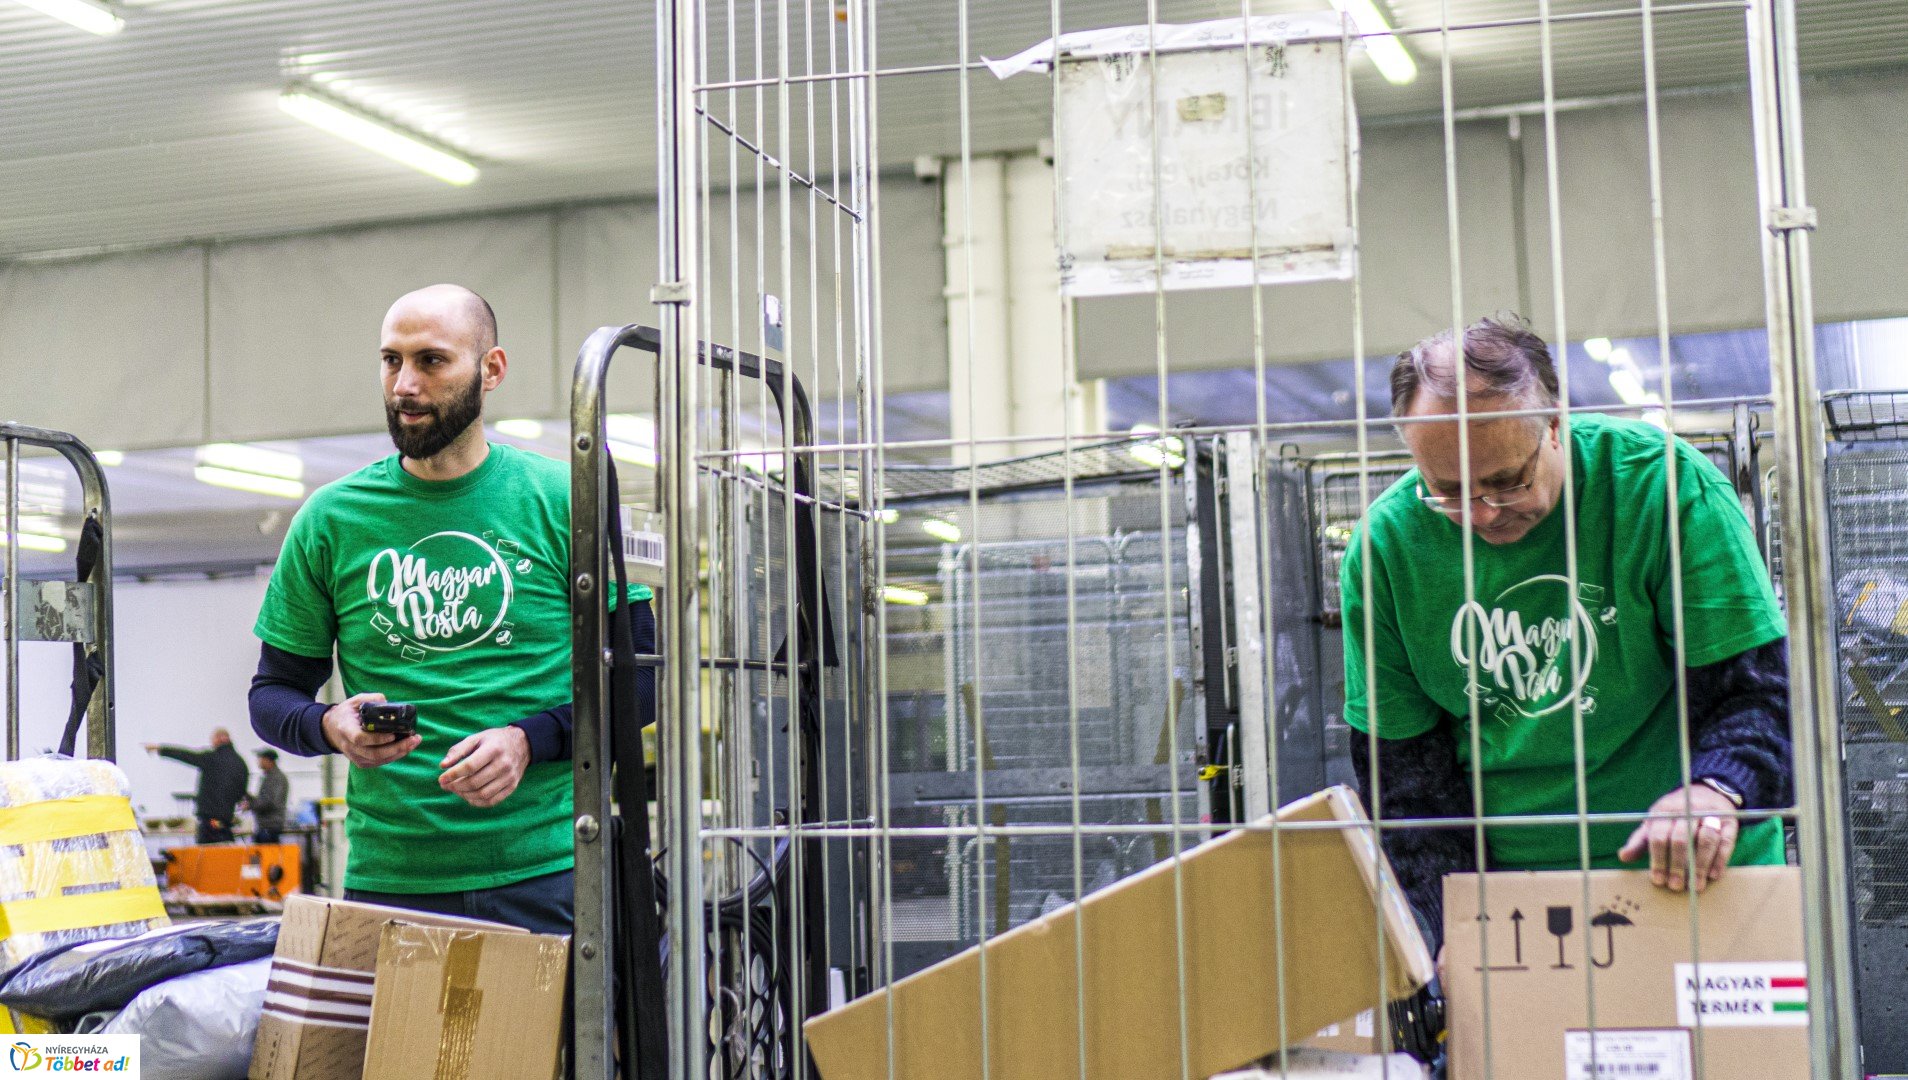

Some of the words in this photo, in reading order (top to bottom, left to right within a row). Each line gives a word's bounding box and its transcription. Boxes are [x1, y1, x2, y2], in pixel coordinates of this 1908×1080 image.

[367, 548, 497, 608] Magyar
[396, 586, 483, 640] Posta
[1686, 977, 1765, 991] MAGYAR
[1691, 999, 1764, 1014] TERMÉK
